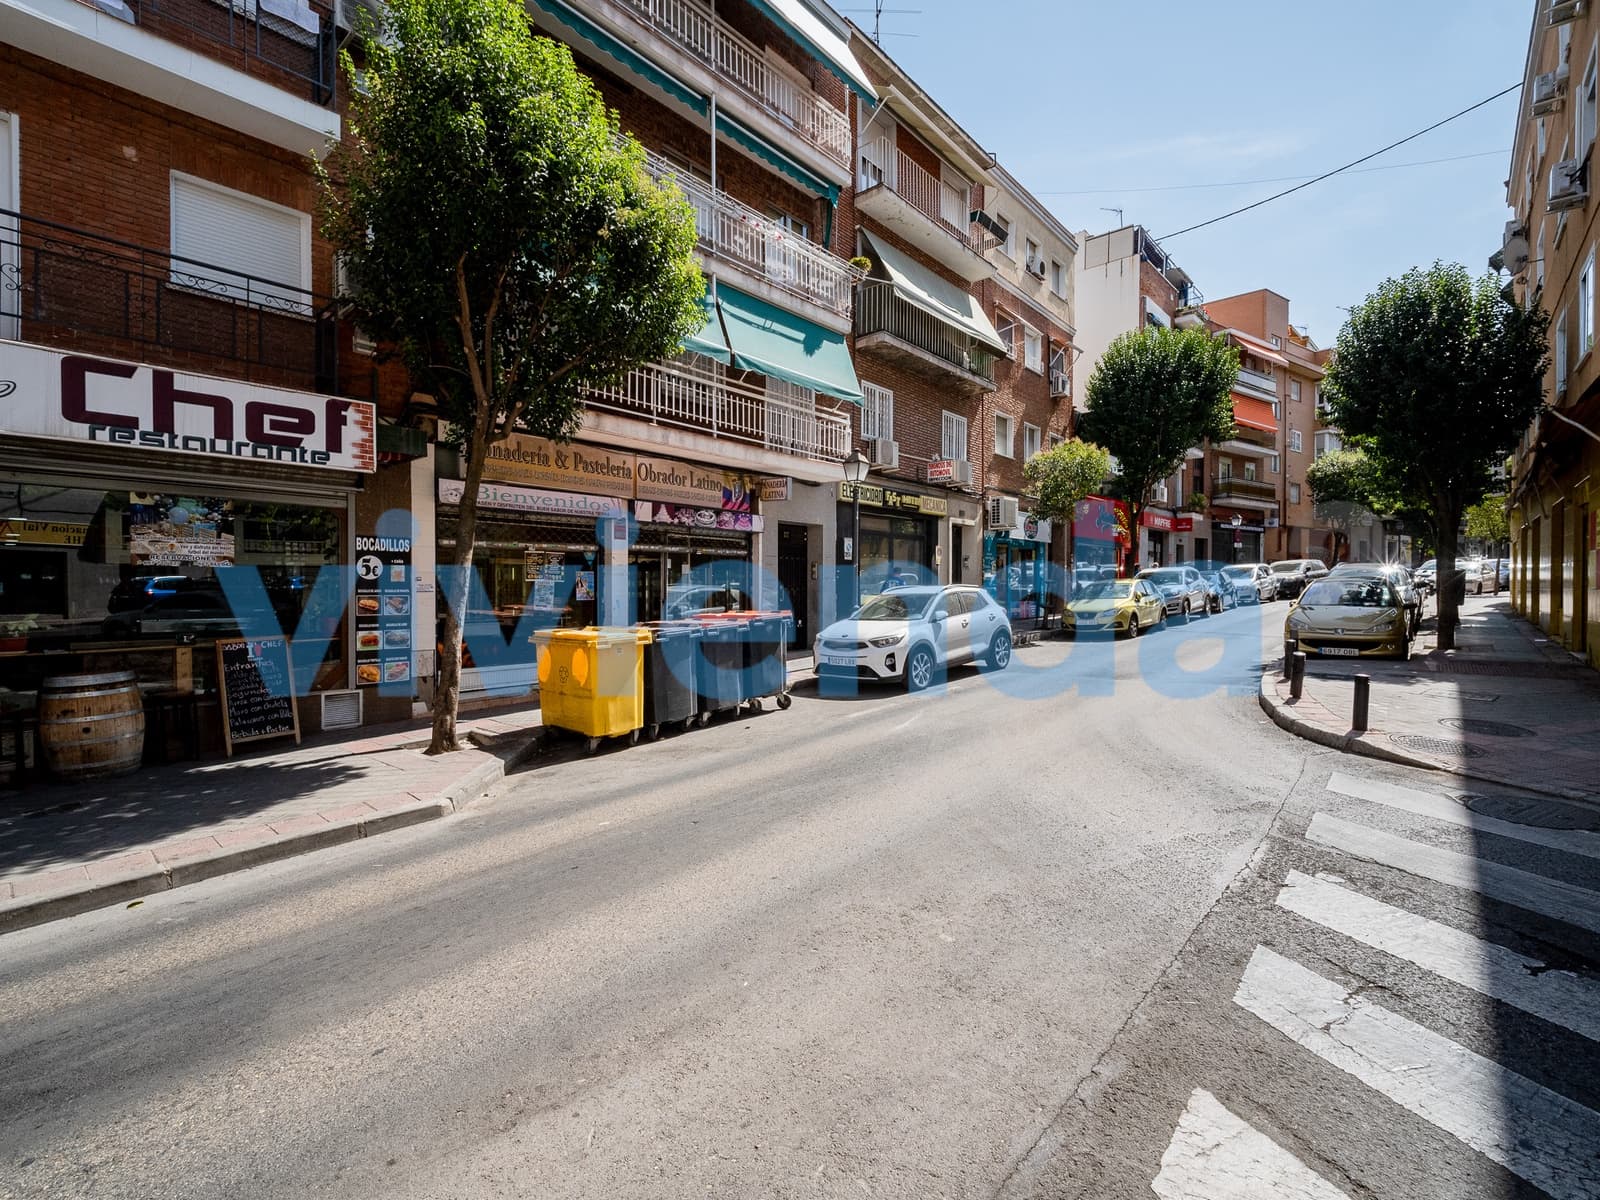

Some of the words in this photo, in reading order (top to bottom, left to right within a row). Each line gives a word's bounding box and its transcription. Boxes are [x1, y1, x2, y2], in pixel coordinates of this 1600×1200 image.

[61, 356, 351, 453] Chef
[88, 424, 331, 465] restaurante
[486, 441, 550, 467] nadería
[555, 450, 570, 470] &
[573, 451, 632, 479] Pastelería
[637, 463, 687, 486] Obrador
[689, 471, 722, 492] Latino
[478, 486, 611, 512] Bienvenidos
[842, 483, 883, 503] ELERICIDAD
[356, 536, 410, 552] BOCADILLOS
[150, 553, 216, 561] RESERVACIONES
[261, 640, 282, 648] CHEF
